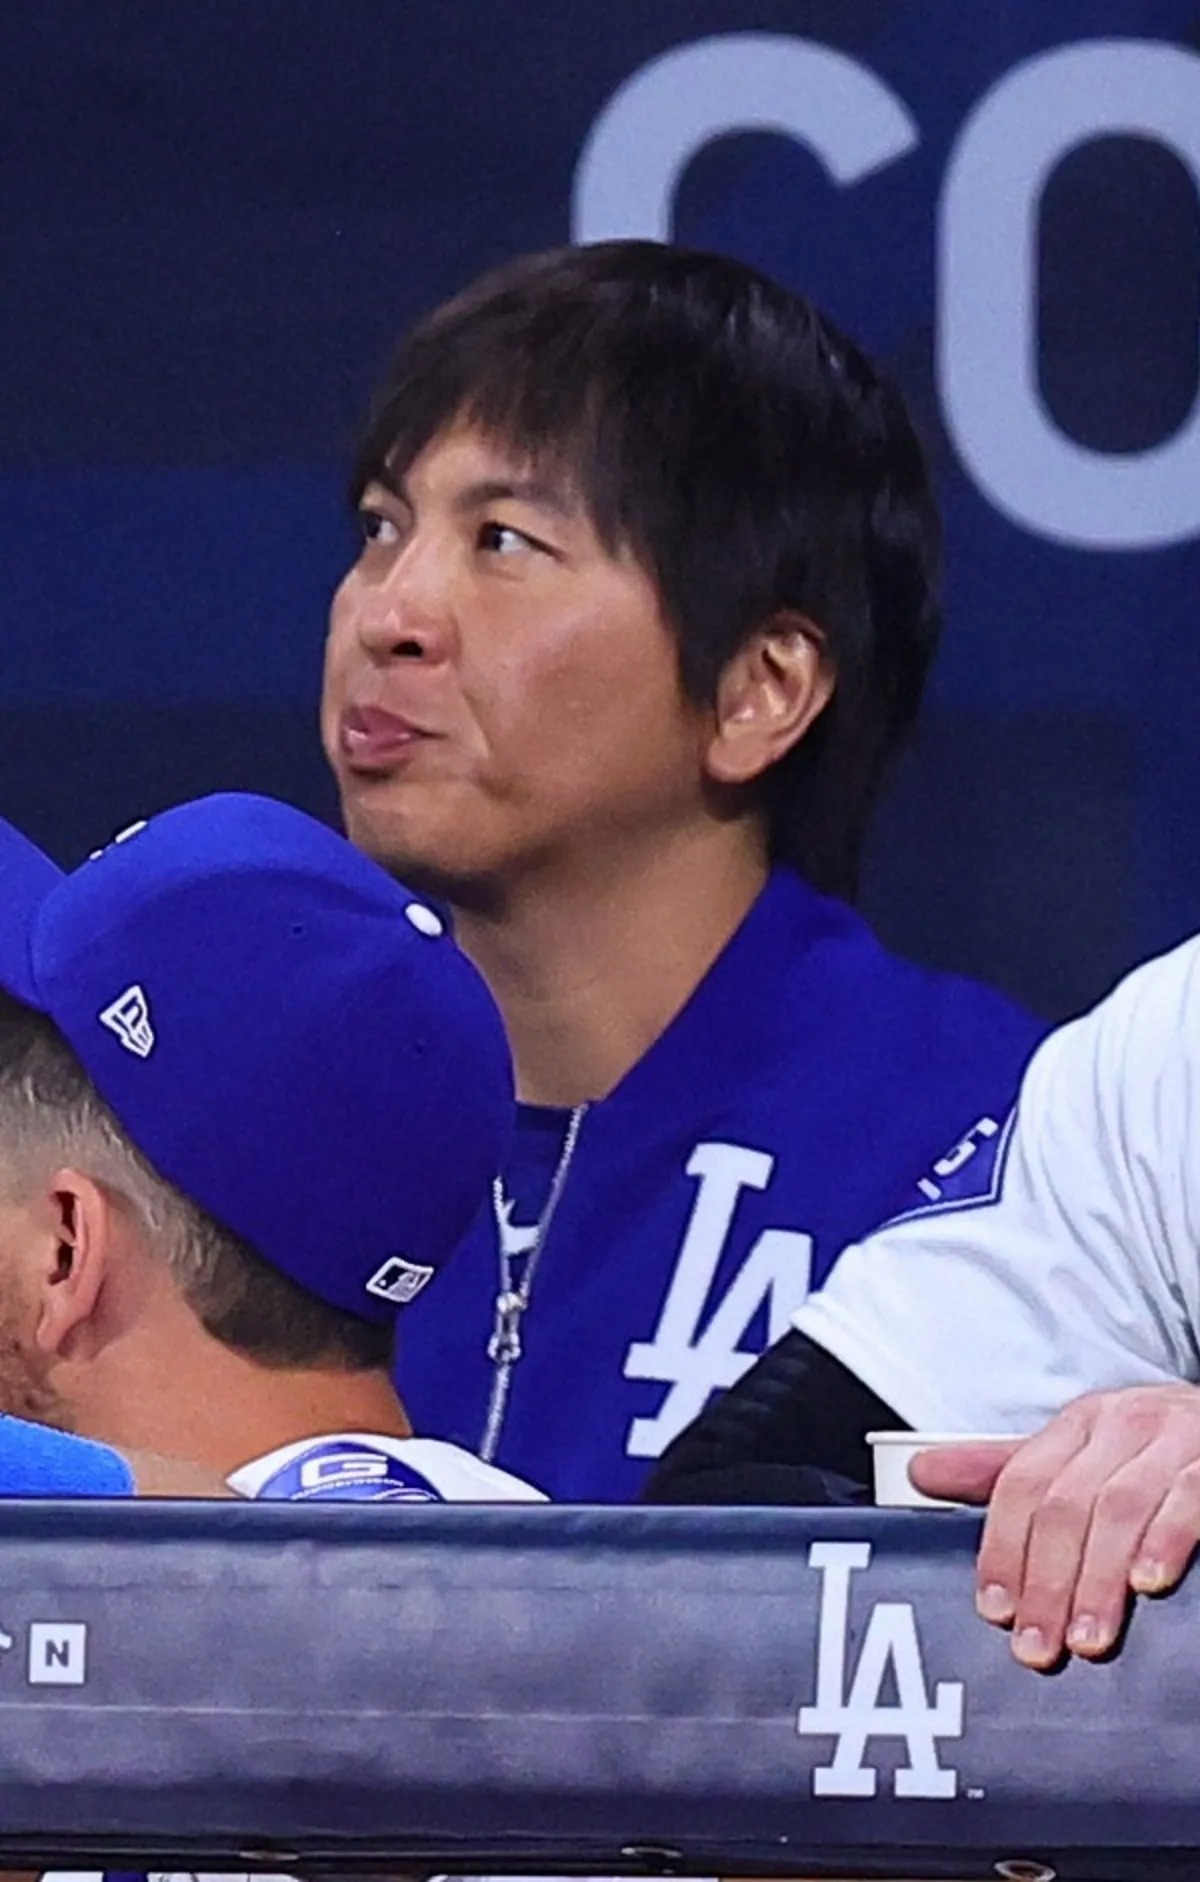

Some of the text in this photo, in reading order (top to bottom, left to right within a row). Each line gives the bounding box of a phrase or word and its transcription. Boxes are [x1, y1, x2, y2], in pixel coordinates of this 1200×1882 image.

[623, 1142, 815, 1458] LA
[45, 1639, 69, 1668] N
[799, 1542, 963, 1797] LA
